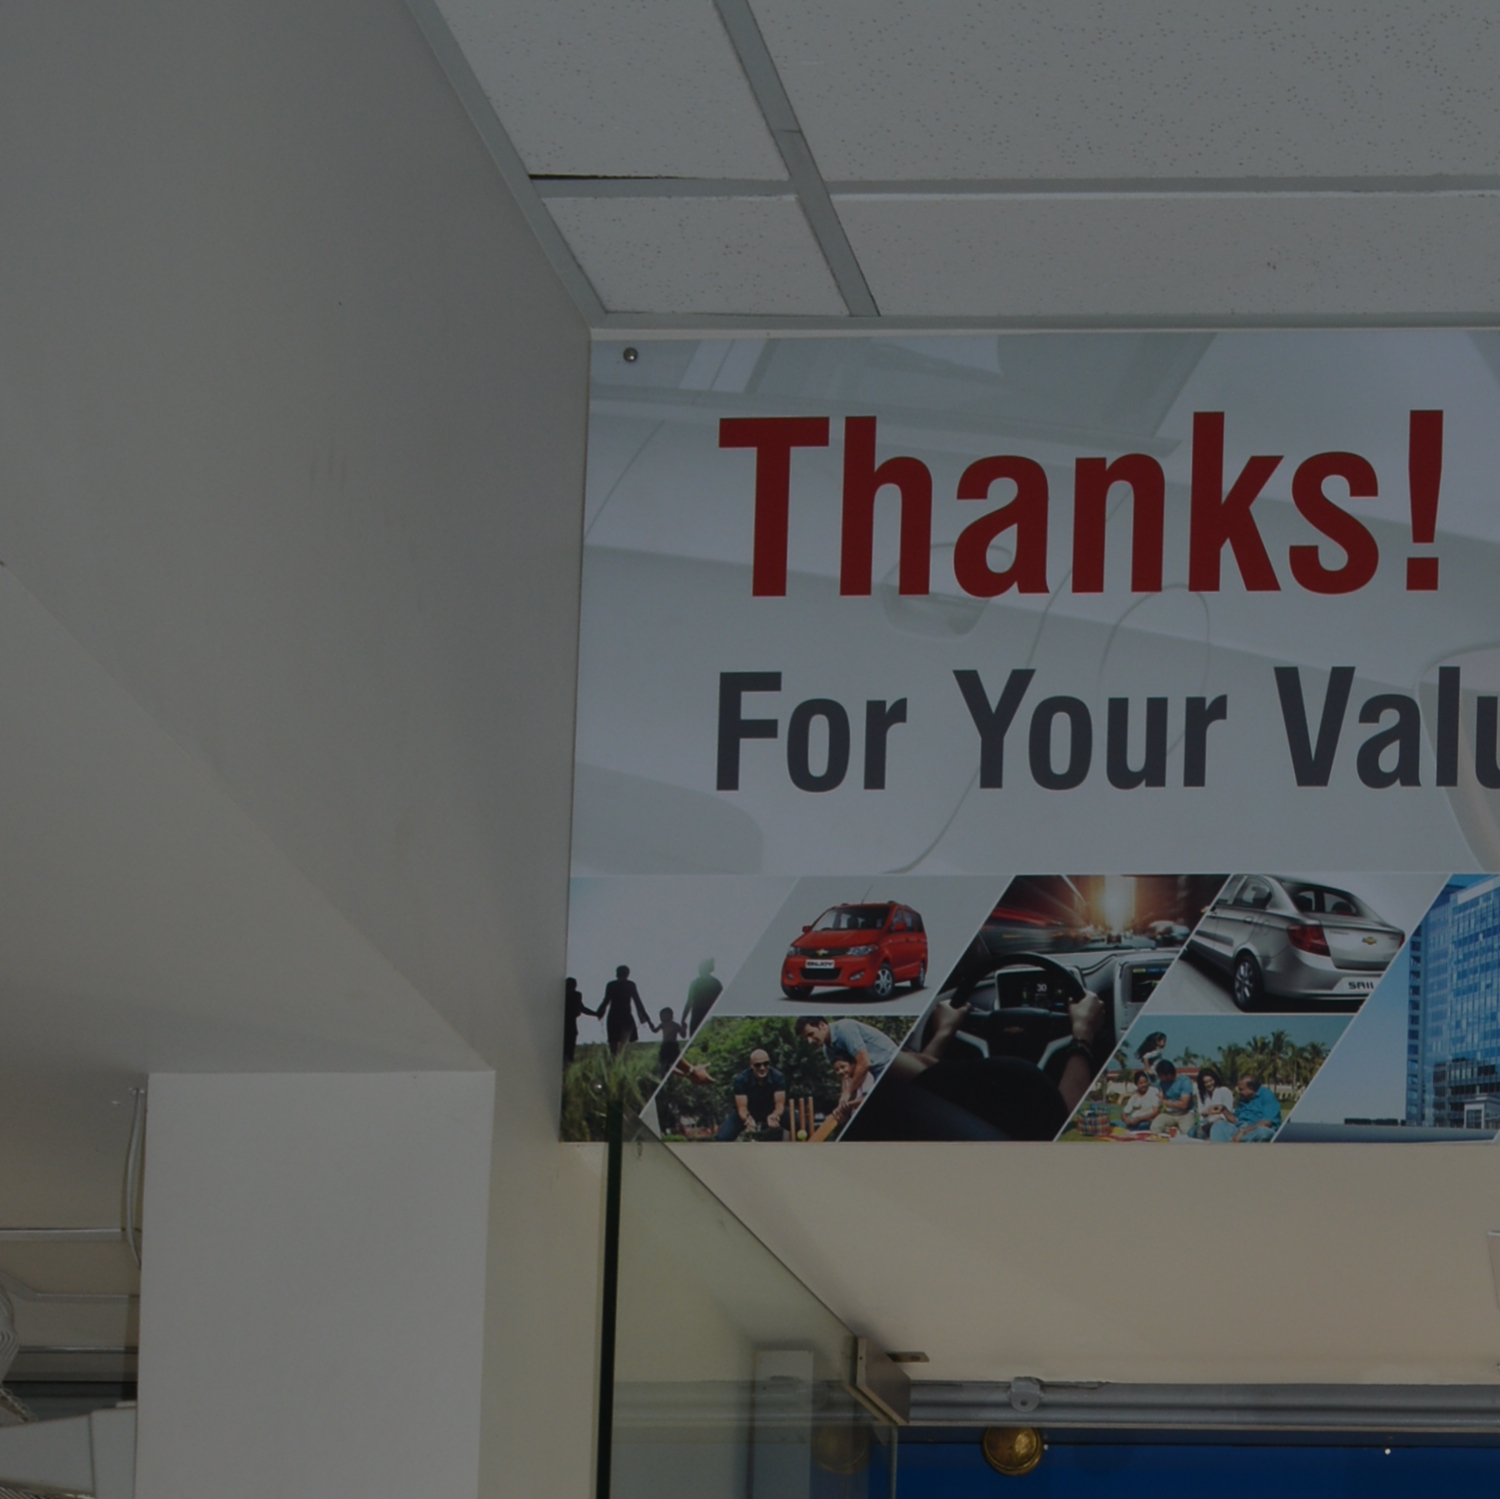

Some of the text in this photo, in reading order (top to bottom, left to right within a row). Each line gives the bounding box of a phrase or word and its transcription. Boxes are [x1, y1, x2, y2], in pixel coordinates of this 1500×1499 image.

[717, 410, 1445, 599] Thanks!
[715, 670, 907, 794] For
[952, 668, 1227, 792] Your
